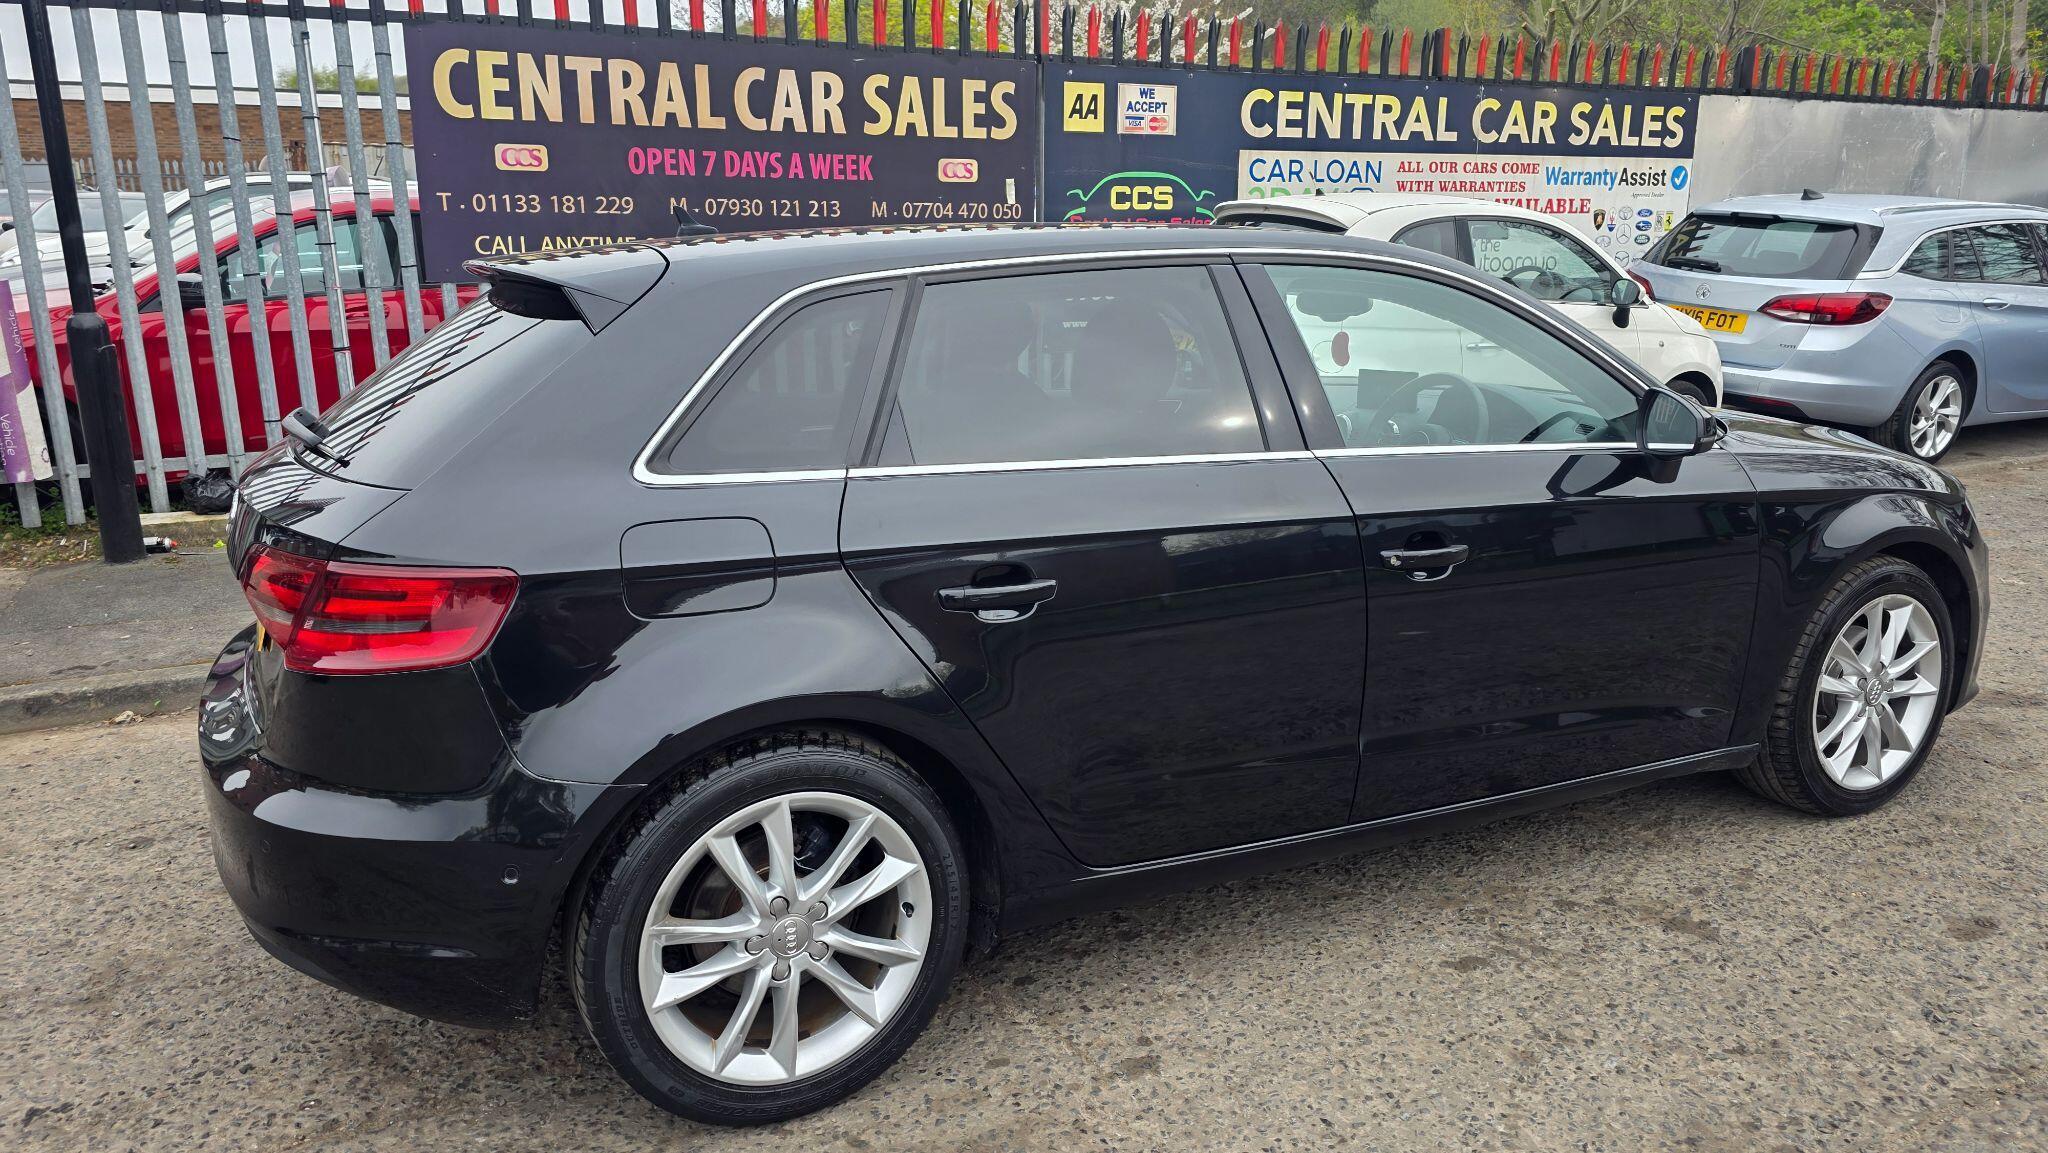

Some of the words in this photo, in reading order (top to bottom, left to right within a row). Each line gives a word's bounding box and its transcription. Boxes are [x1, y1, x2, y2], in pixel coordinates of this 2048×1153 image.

[433, 48, 726, 129] CENTRAL
[734, 67, 847, 134] CAR
[863, 74, 1017, 140] SALES
[1139, 88, 1155, 99] WE
[1068, 93, 1098, 119] AA
[1126, 101, 1167, 113] ACCEPT
[1240, 89, 1458, 141] CENTRAL
[1472, 98, 1558, 144] CAR
[1568, 102, 1686, 148] SALES
[501, 148, 542, 167] CCS
[628, 147, 696, 176] OPEN
[702, 151, 716, 177] 7
[724, 151, 783, 179] DAYS
[788, 153, 804, 179] A
[809, 153, 874, 181] WEEK
[942, 162, 973, 179] CCS
[1249, 158, 1304, 183] CAR
[1314, 159, 1382, 183] LOAN
[1397, 161, 1423, 173] ALL
[1429, 162, 1458, 174] OUR
[1463, 162, 1498, 174] CARS
[1501, 162, 1540, 174] COME
[1396, 181, 1434, 192] WITH
[1439, 181, 1526, 193] WARRANTIES
[472, 194, 541, 213] 01133
[551, 196, 585, 214] 181
[595, 197, 634, 215] 229
[705, 198, 763, 216] 07930
[771, 200, 800, 217] 121
[809, 200, 840, 217] 213
[1110, 185, 1174, 211] CCS
[1495, 198, 1591, 214] AILABLE
[903, 202, 953, 218] 07704
[958, 203, 987, 218] 470
[993, 203, 1022, 219] 050
[475, 235, 527, 254] CALL
[1480, 239, 1501, 252] the
[1705, 312, 1738, 328] FOT
[8, 309, 22, 353] Vehicle
[1, 413, 16, 456] Vehicle
